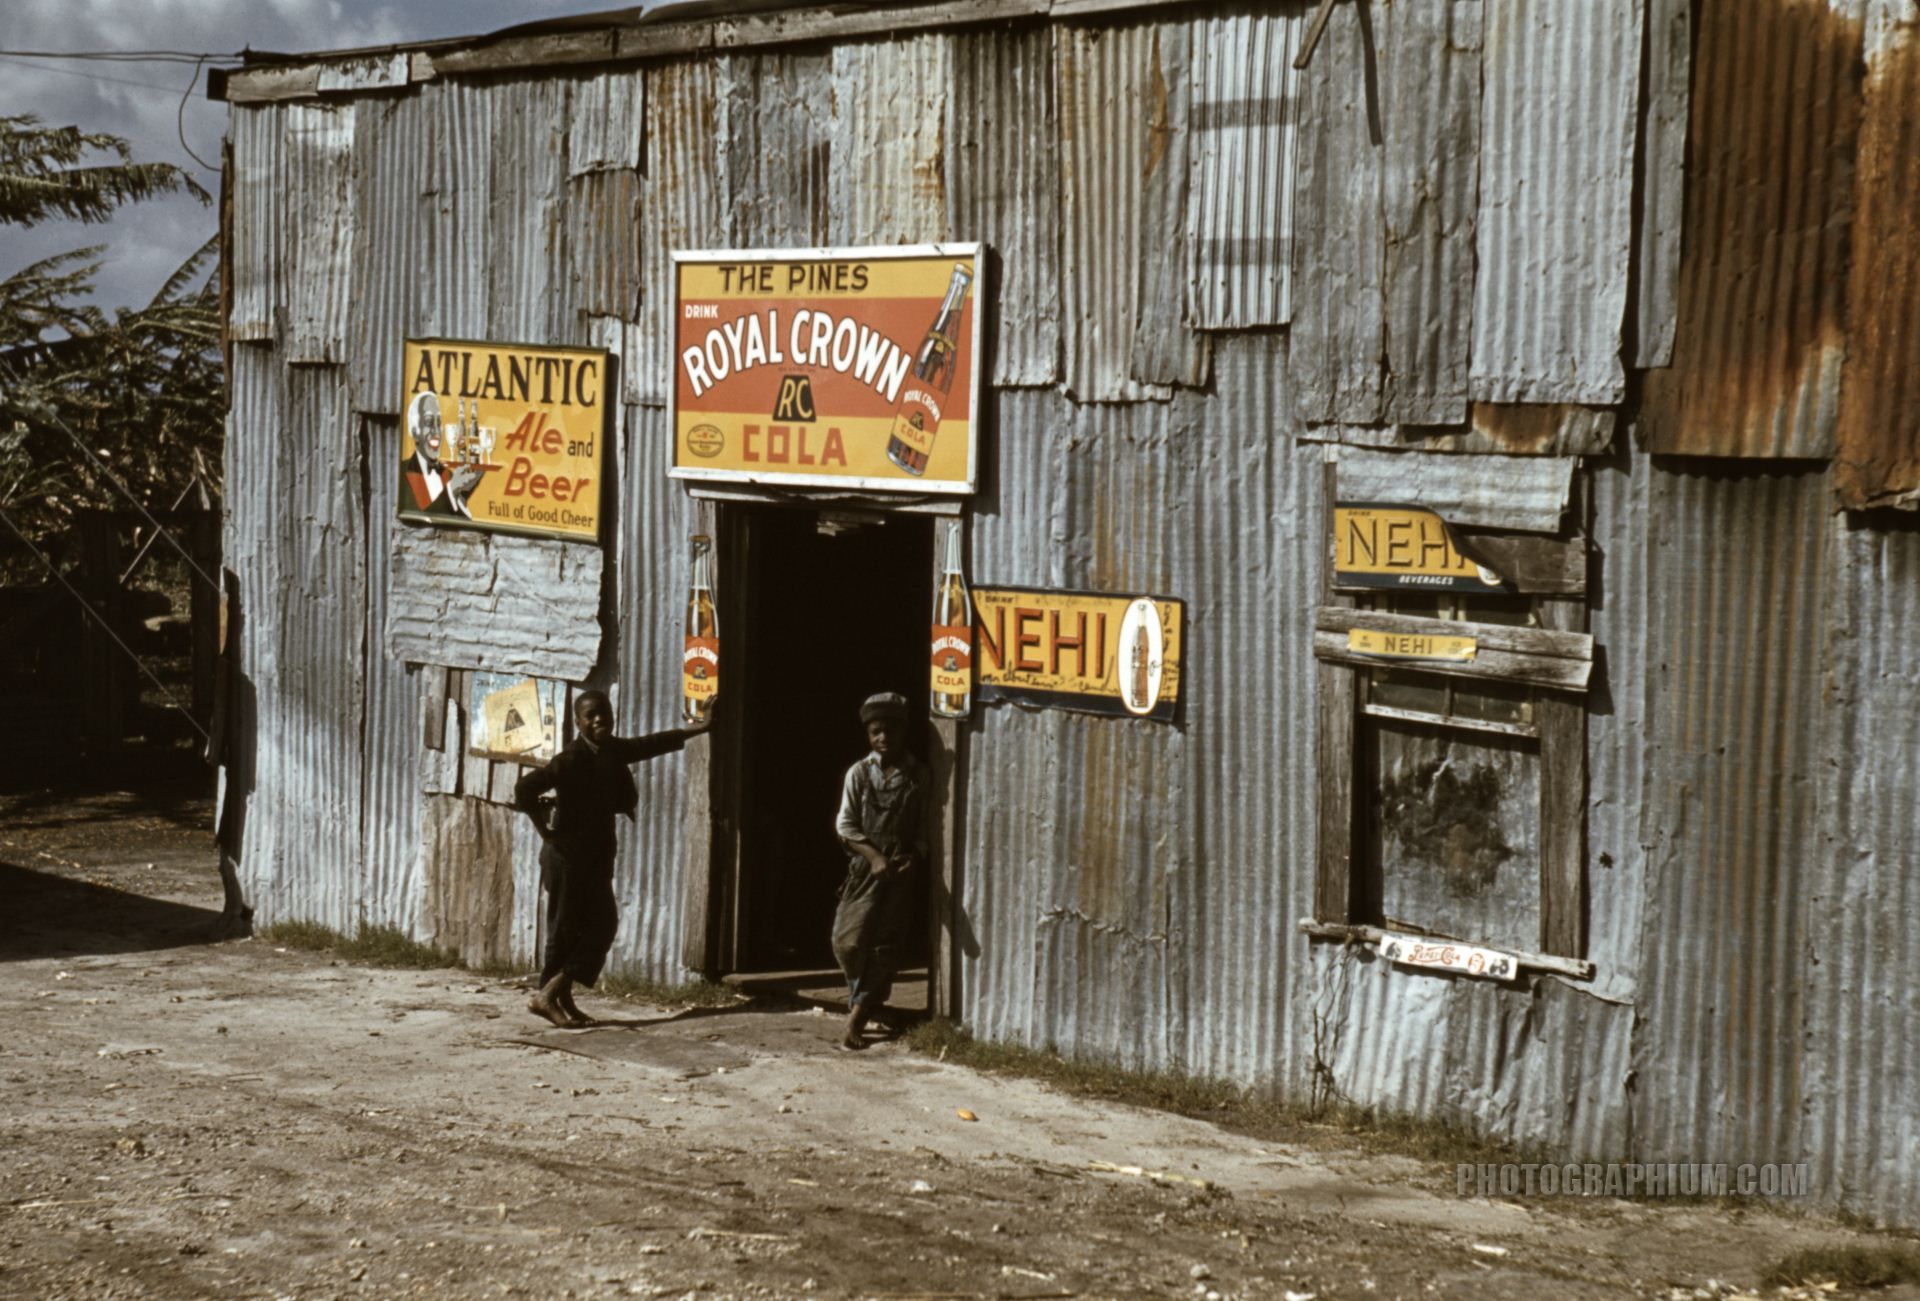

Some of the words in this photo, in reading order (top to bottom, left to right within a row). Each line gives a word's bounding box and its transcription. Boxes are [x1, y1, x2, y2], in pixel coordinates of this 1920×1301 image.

[719, 265, 774, 292] THE
[788, 264, 869, 291] PINES
[684, 303, 719, 319] DRINK
[682, 309, 783, 398] ROYAL
[789, 309, 912, 404] CROWN
[411, 349, 597, 408] ATLANTIC
[778, 379, 812, 418] RC
[505, 411, 563, 455] Ale
[567, 432, 594, 458] and
[742, 424, 848, 467] COLA
[900, 423, 926, 446] COLA
[504, 456, 590, 503] Beer
[488, 500, 510, 518] Full
[513, 504, 524, 519] of
[528, 504, 558, 523] Good
[561, 509, 594, 528] Cheer
[1398, 574, 1454, 586] BEVERAGES
[1385, 635, 1433, 655] NEHI
[687, 682, 713, 693] COLA
[936, 674, 966, 687] COLA
